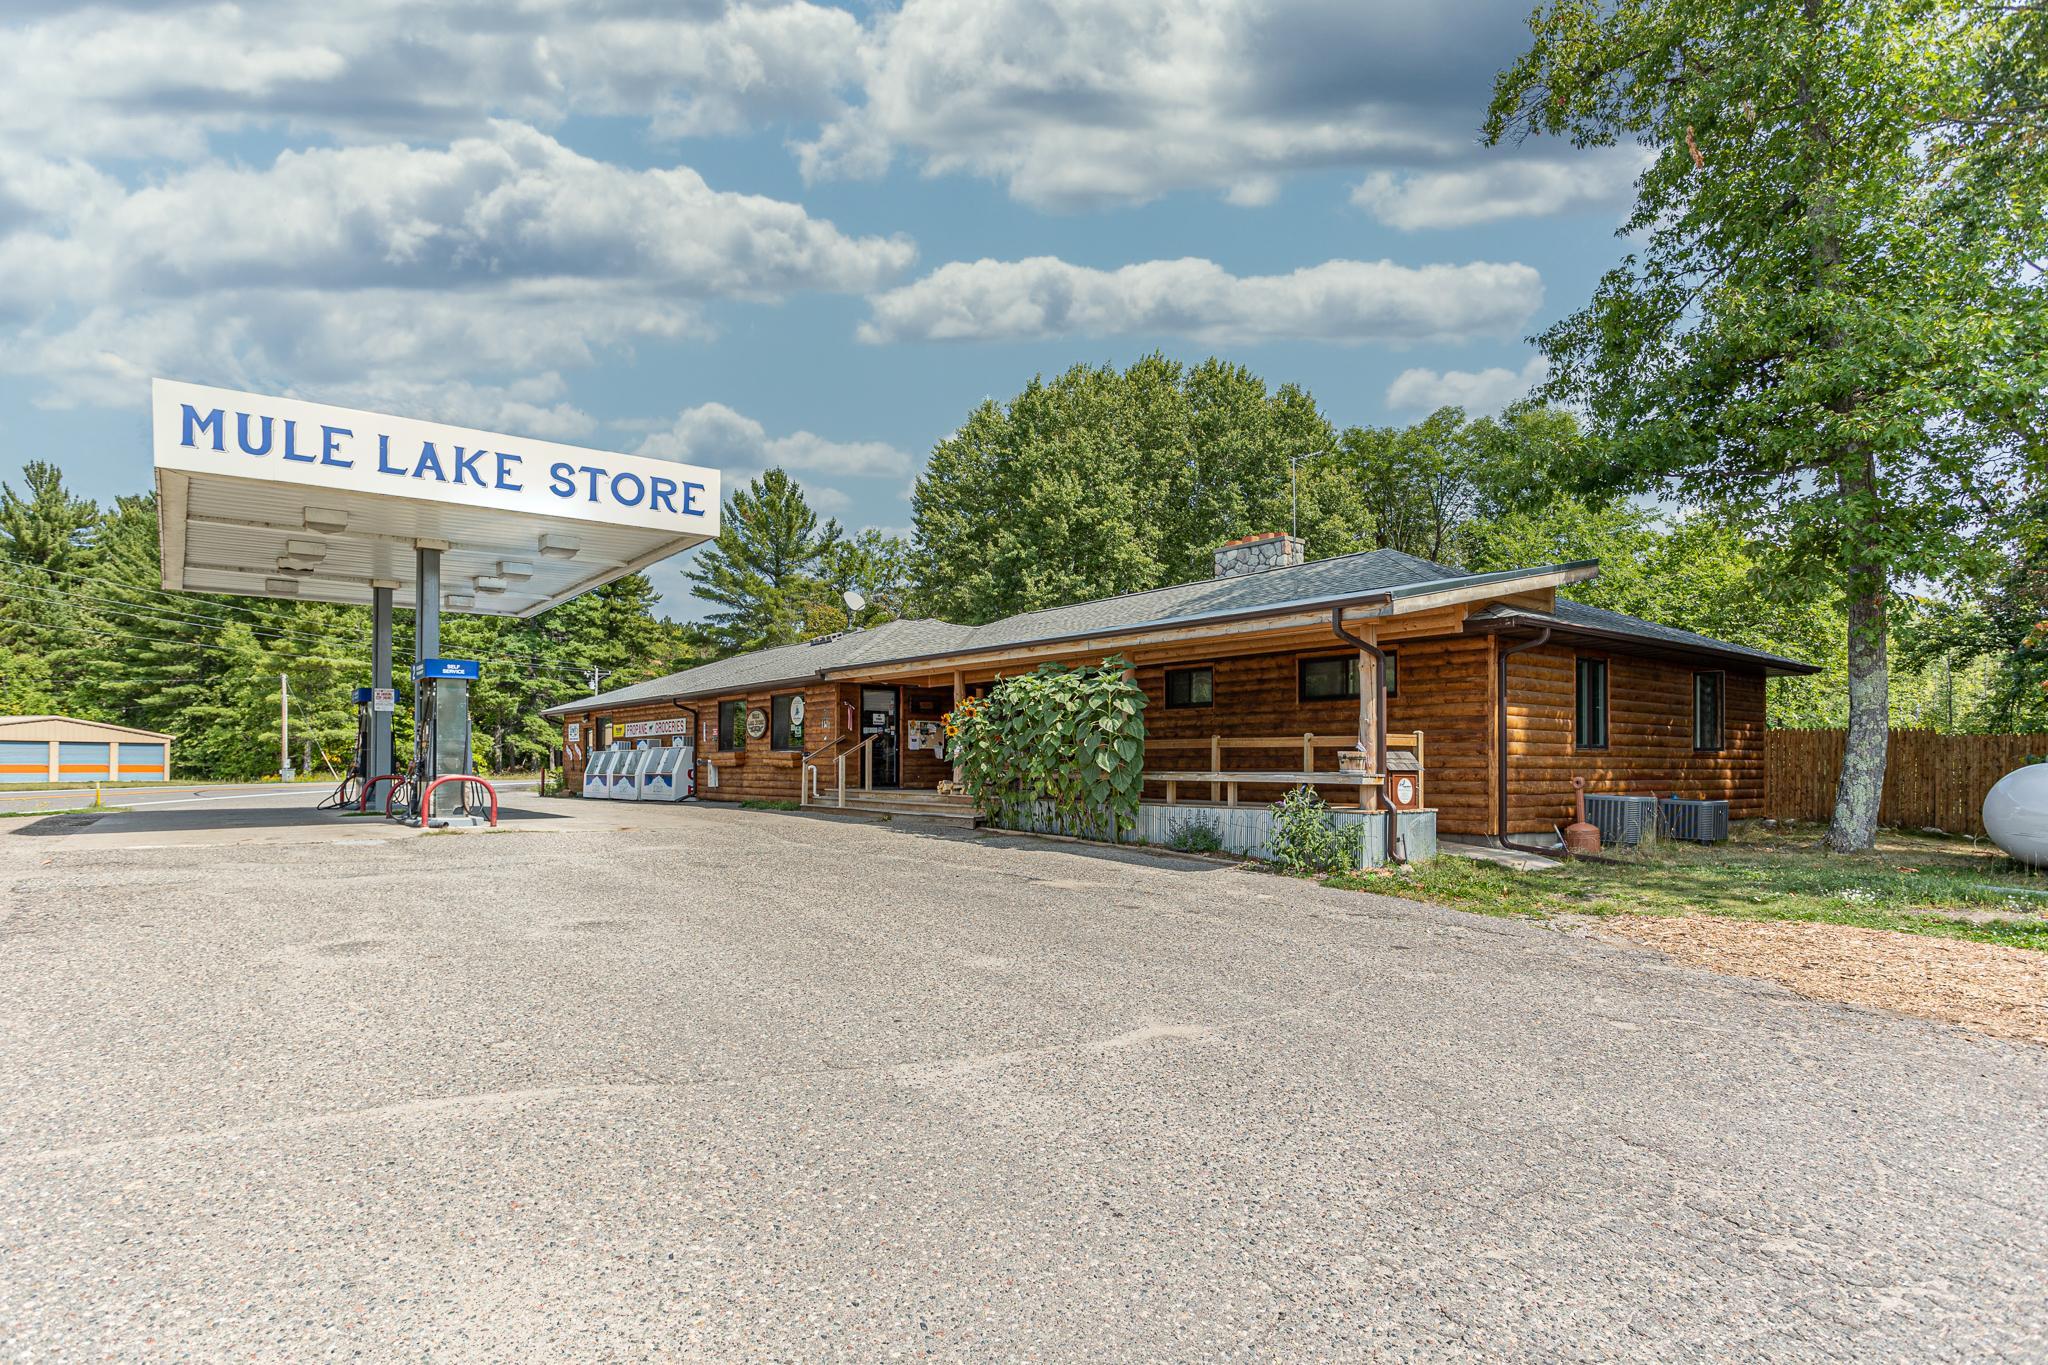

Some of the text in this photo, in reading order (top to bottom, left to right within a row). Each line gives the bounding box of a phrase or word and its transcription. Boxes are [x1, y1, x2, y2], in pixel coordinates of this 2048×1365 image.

[180, 403, 707, 518] MULE LAKE STORE
[626, 723, 648, 736] PROPANE
[655, 720, 684, 734] GROCERIES
